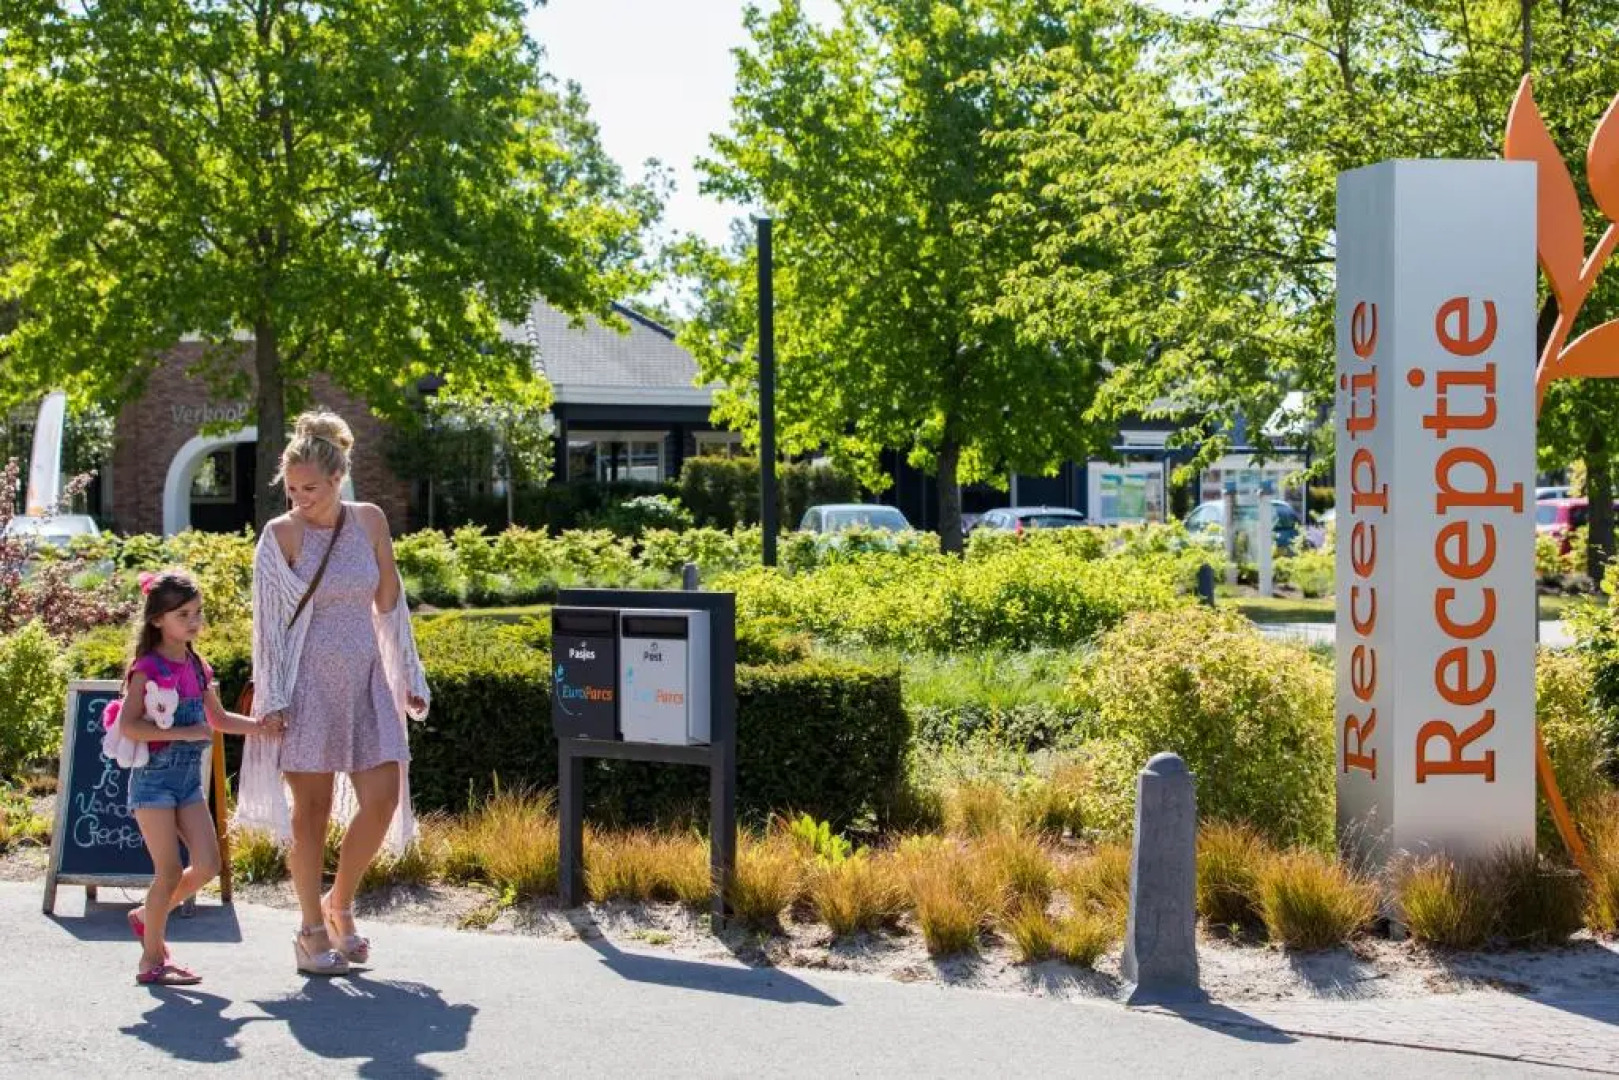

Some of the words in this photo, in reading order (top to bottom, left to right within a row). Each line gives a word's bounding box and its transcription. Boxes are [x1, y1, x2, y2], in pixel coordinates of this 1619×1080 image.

[568, 647, 596, 662] Pasjes
[643, 651, 662, 662] Post
[1341, 300, 1389, 781] Receptie
[1407, 296, 1524, 784] Receptie
